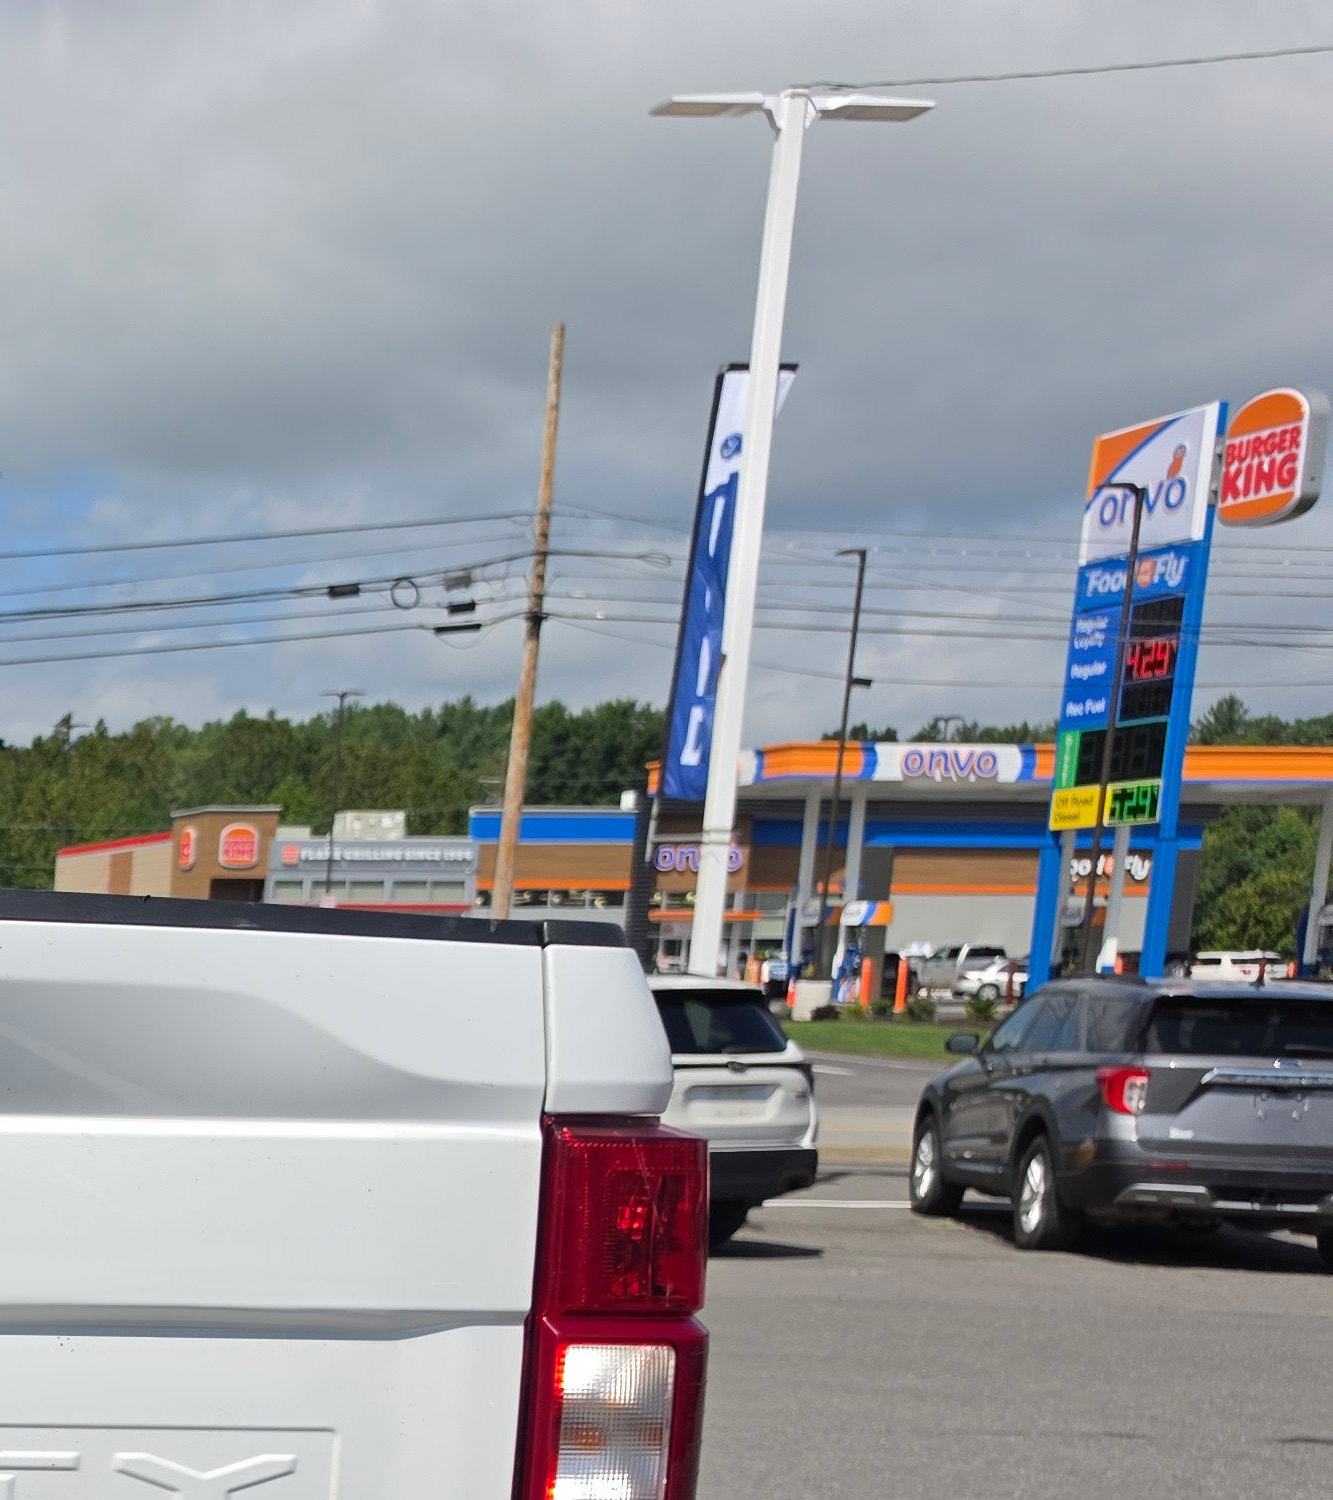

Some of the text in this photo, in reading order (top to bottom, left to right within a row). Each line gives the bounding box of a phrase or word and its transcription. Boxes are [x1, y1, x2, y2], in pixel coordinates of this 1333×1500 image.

[1225, 425, 1302, 468] BURGER
[1221, 451, 1298, 503] KING
[901, 749, 998, 778] onvo
[654, 844, 743, 872] ono
